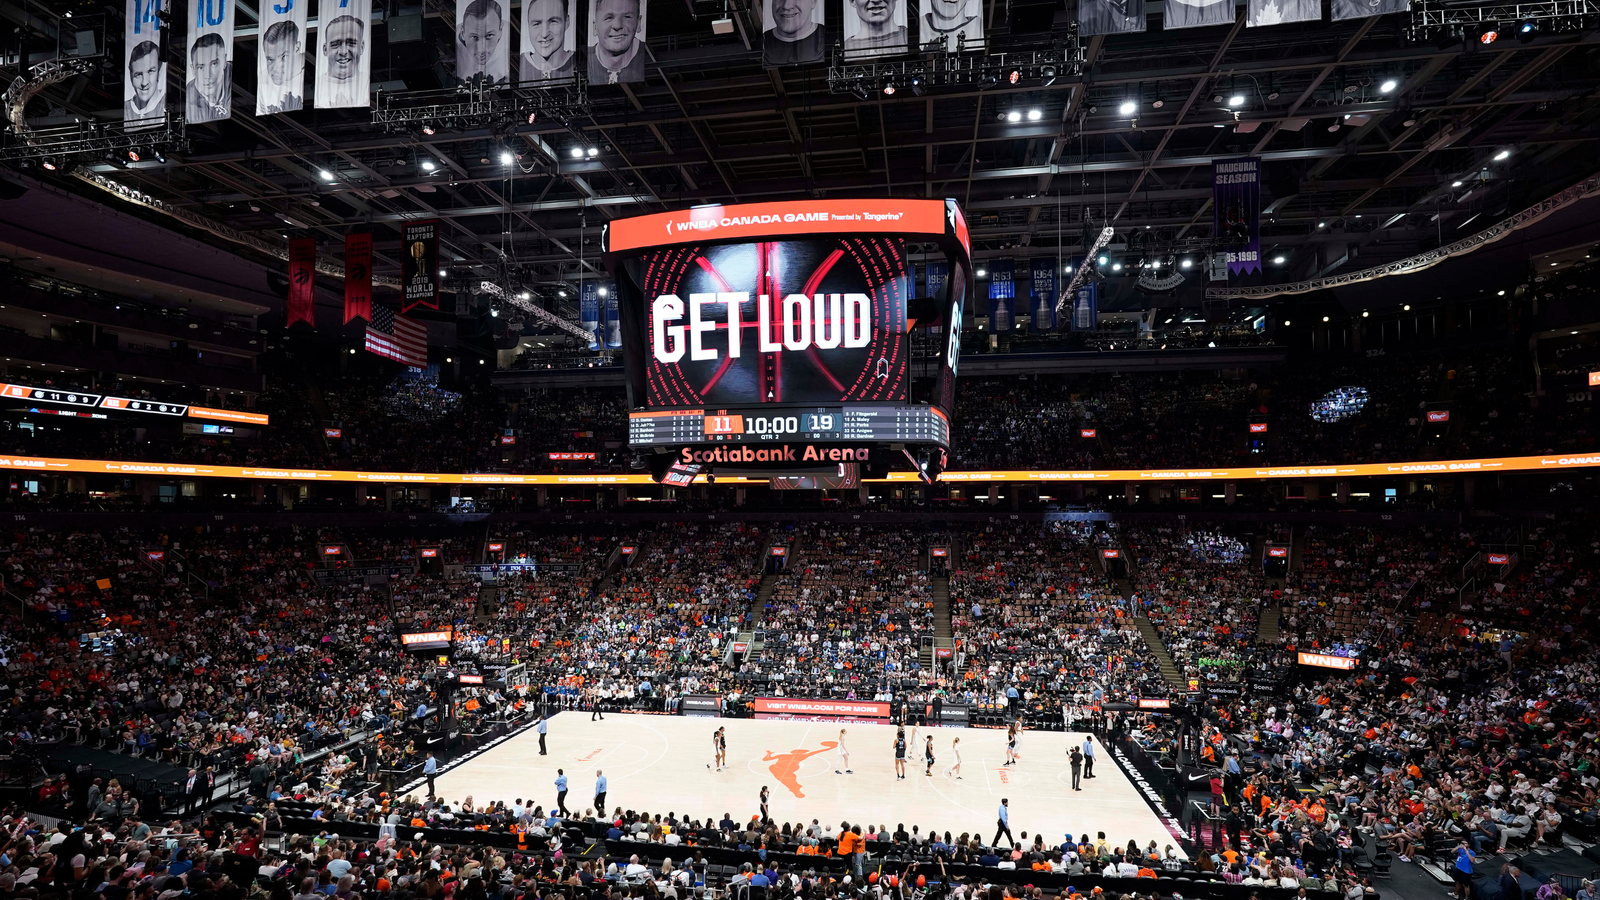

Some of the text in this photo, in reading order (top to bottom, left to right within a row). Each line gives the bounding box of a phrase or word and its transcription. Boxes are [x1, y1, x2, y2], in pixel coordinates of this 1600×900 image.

[1216, 162, 1257, 173] INAUGURAL
[1216, 173, 1256, 184] SEASON
[676, 220, 718, 231] WNBA
[720, 214, 782, 227] CANADA
[784, 212, 828, 222] GAME
[862, 212, 900, 221] Tangerine
[406, 232, 434, 240] RAPTORS
[992, 272, 1011, 281] 1963
[1034, 270, 1052, 279] 1964
[406, 284, 433, 294] WORLD
[583, 292, 596, 300] 1918
[652, 292, 871, 364] GET LOUD
[1566, 391, 1593, 403] 301
[714, 418, 731, 431] 11
[746, 417, 798, 434] 10:00
[812, 416, 832, 430] 19
[682, 445, 869, 463] Scotiabank Arena
[13, 459, 45, 468] GAME
[121, 464, 165, 473] CANADA
[406, 632, 447, 642] WNBA
[1303, 654, 1354, 668] WNBA
[1118, 757, 1162, 801] CANADA GAME
